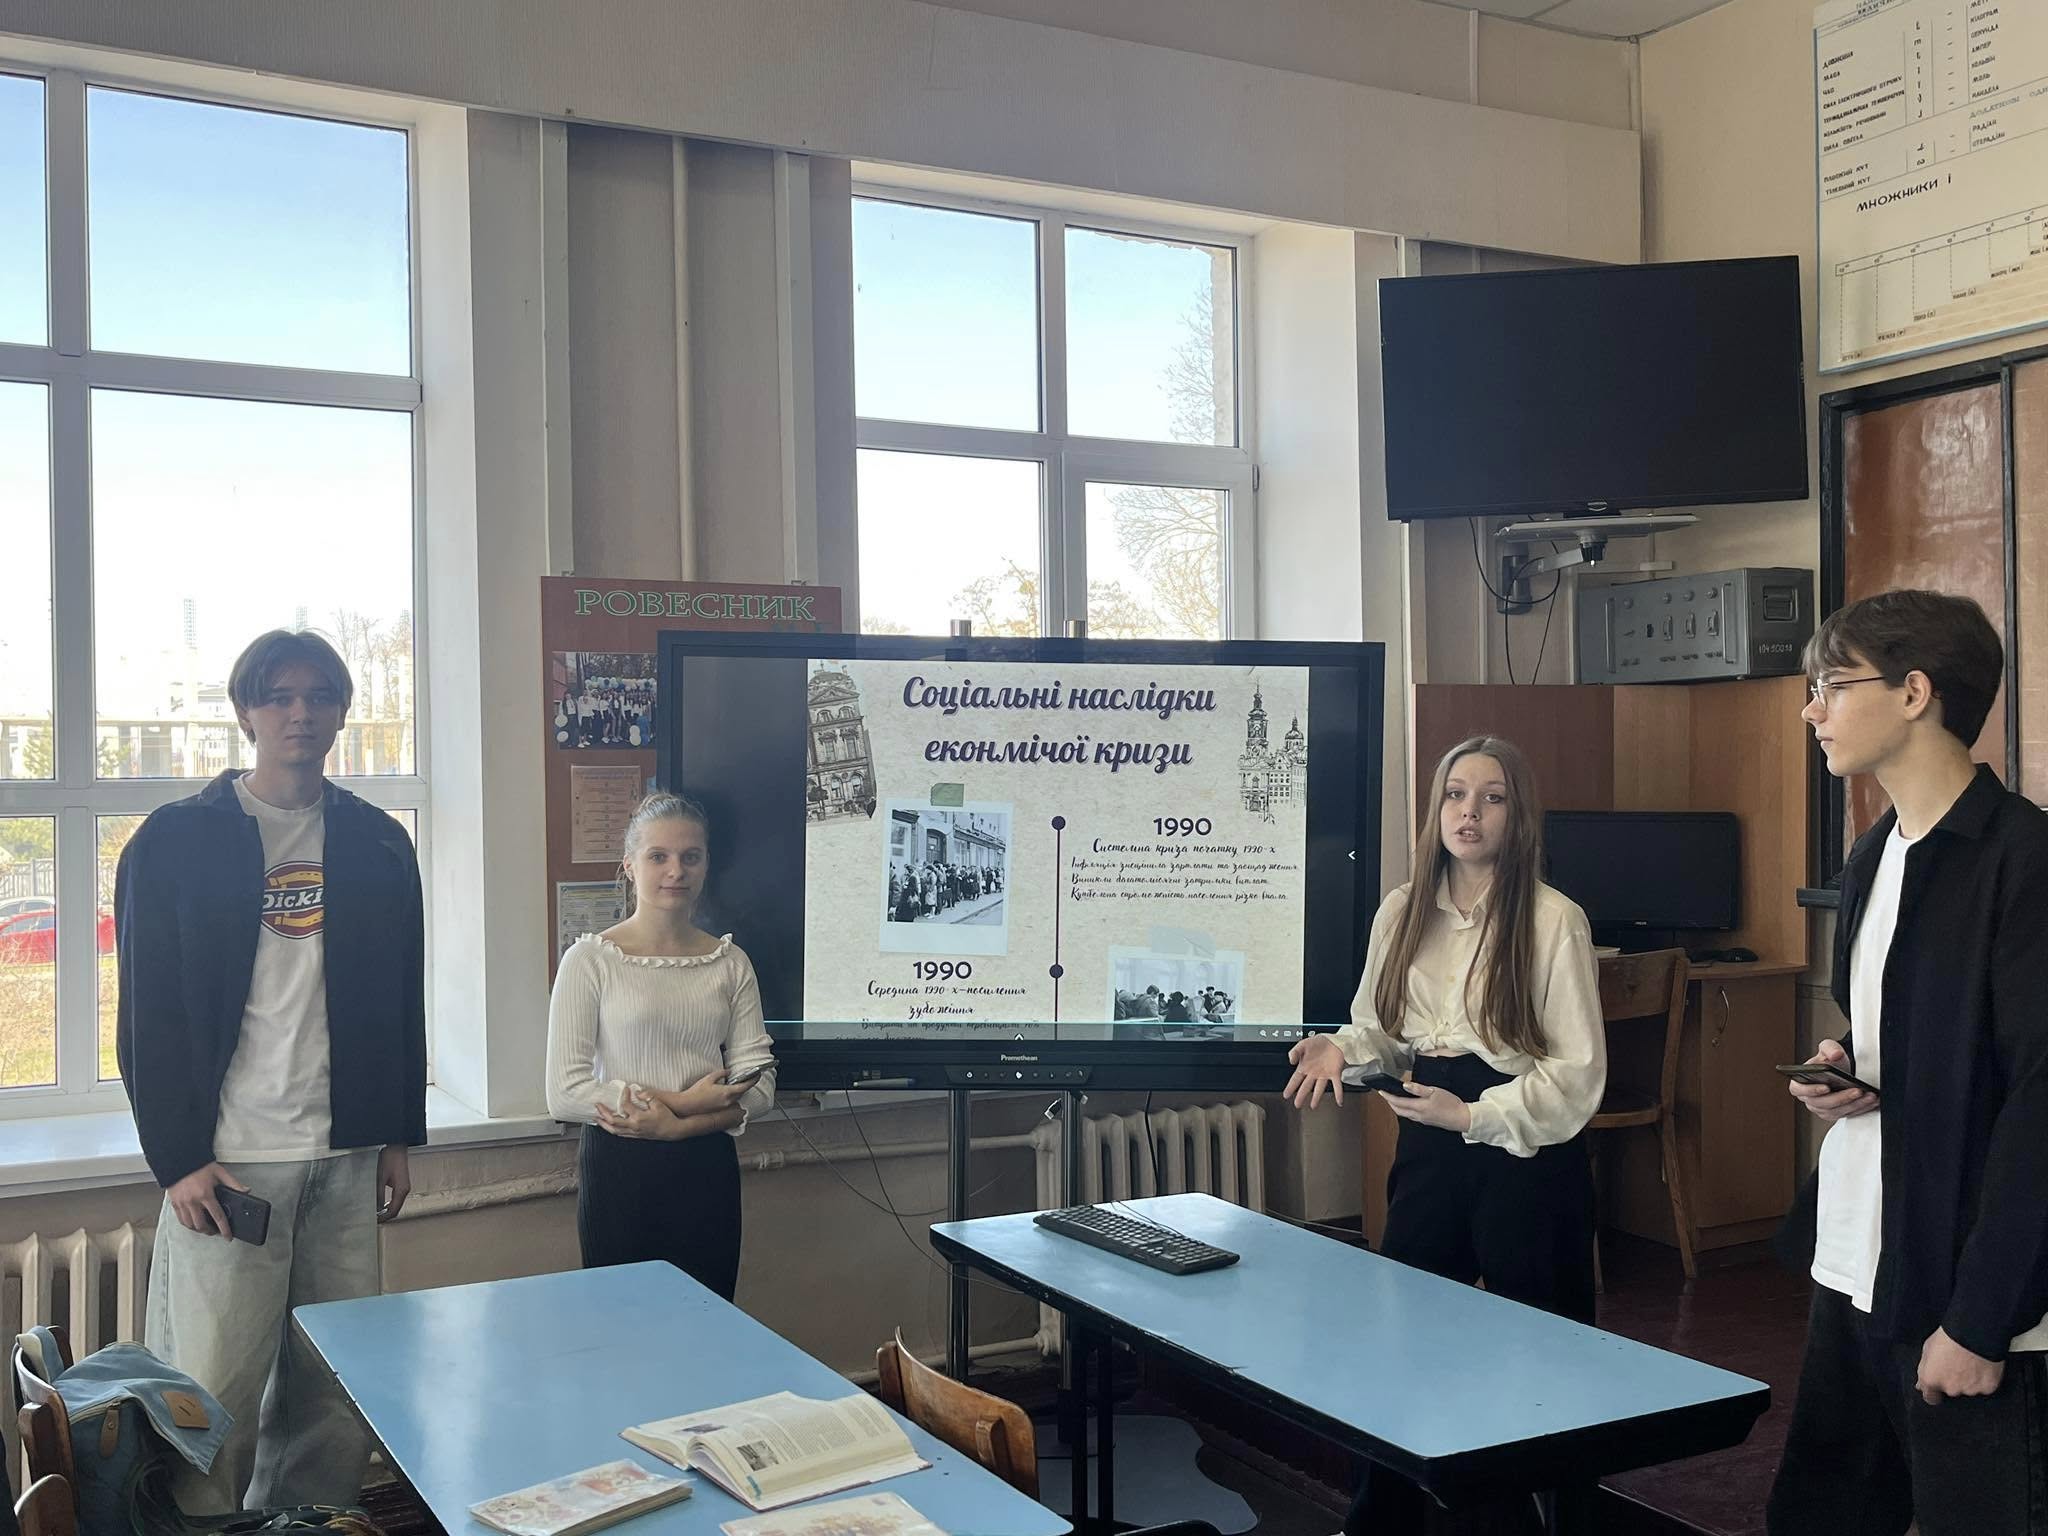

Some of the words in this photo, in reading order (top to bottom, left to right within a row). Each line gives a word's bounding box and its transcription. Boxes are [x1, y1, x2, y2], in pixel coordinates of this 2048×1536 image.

[1857, 178, 1938, 212] МНОЖНИКИ
[574, 589, 816, 620] РОВЕСНИК
[903, 676, 1063, 715] Соціальні
[1068, 682, 1216, 720] наслідки
[924, 734, 1090, 764] еконмічої
[1094, 741, 1192, 774] кризи
[1153, 817, 1212, 837] 1990
[1093, 838, 1150, 853] Системна
[1156, 844, 1188, 858] криза
[1193, 845, 1237, 858] початку
[913, 961, 972, 980] 1990
[868, 980, 919, 999] Середина
[1000, 1054, 1038, 1062] Promethean
